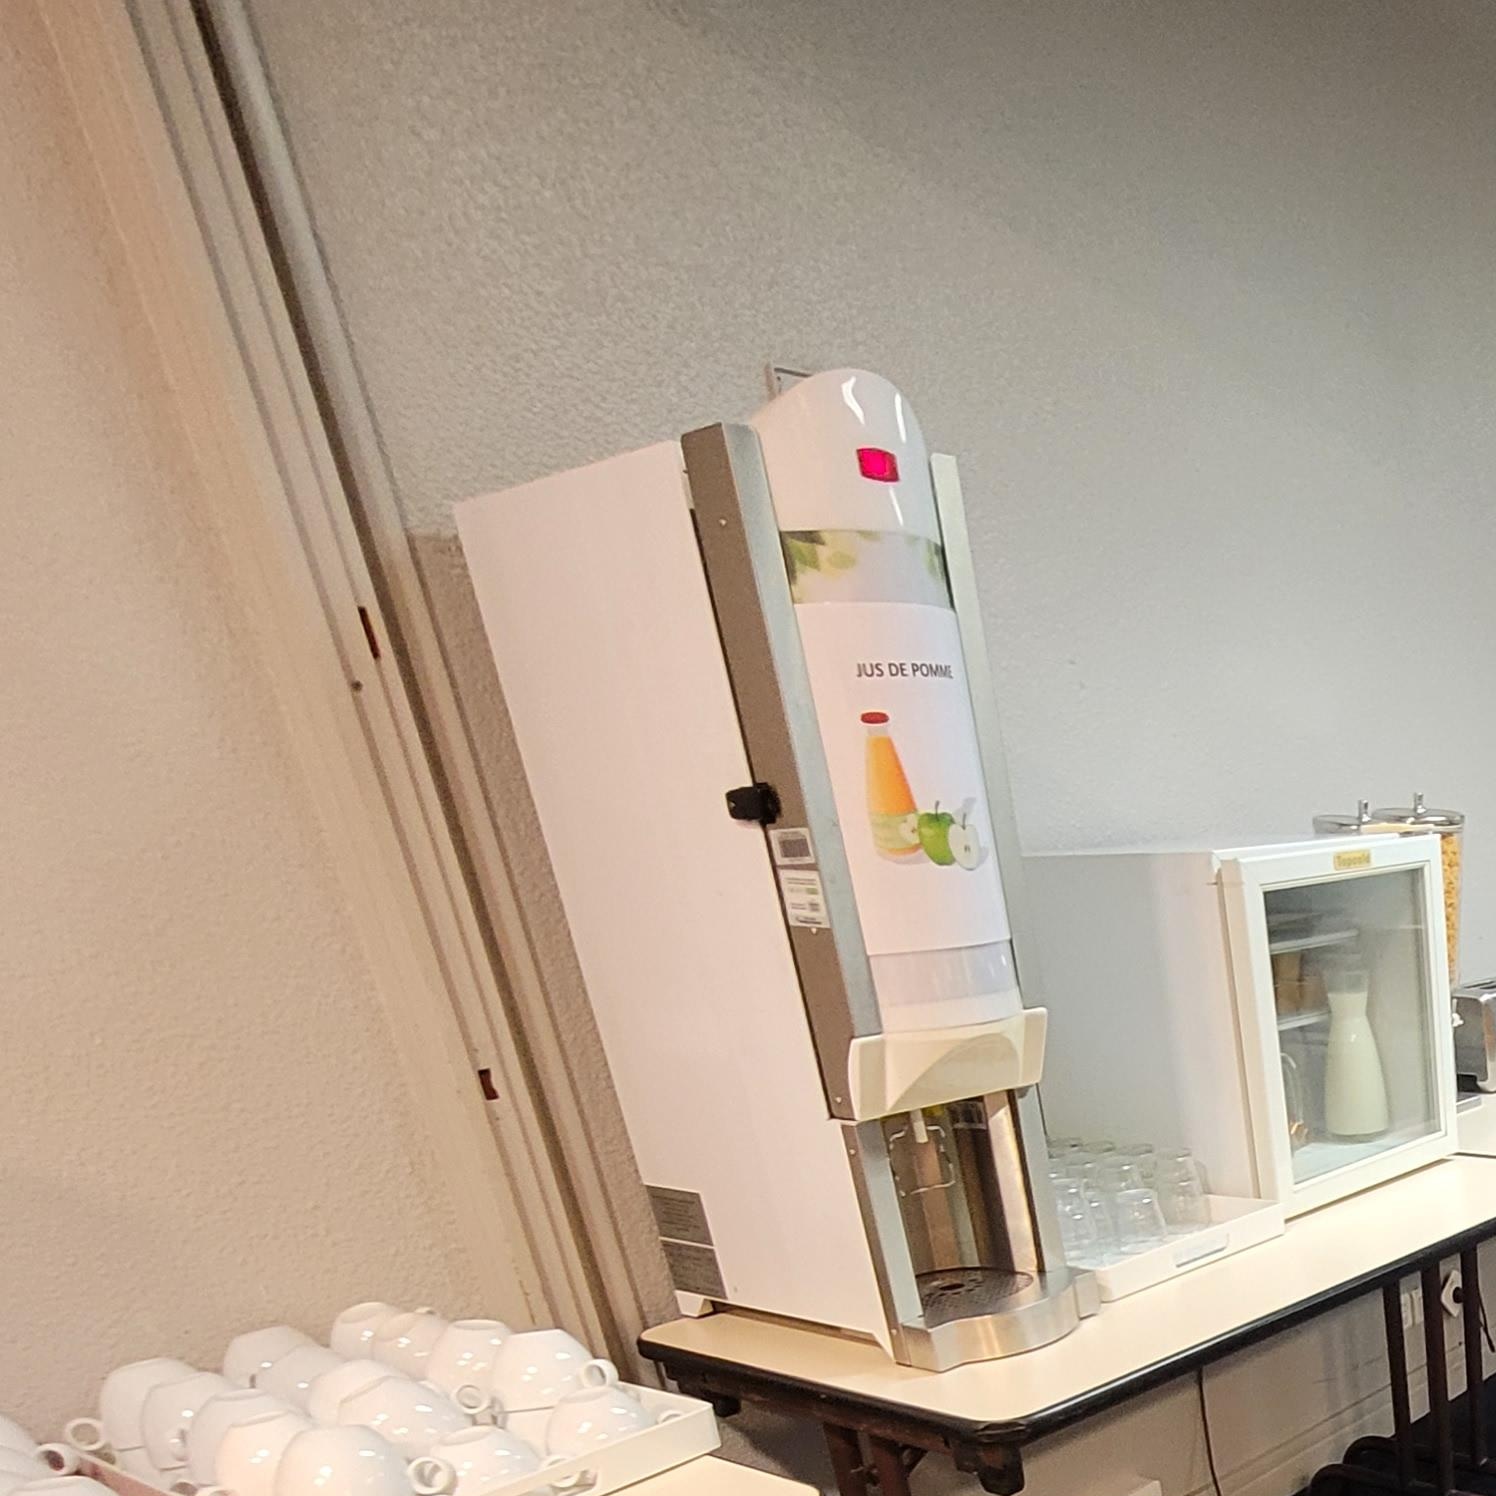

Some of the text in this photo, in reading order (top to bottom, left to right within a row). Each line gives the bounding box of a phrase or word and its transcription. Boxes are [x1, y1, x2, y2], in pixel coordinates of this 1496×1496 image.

[856, 662, 954, 680] JUS DE POMME
